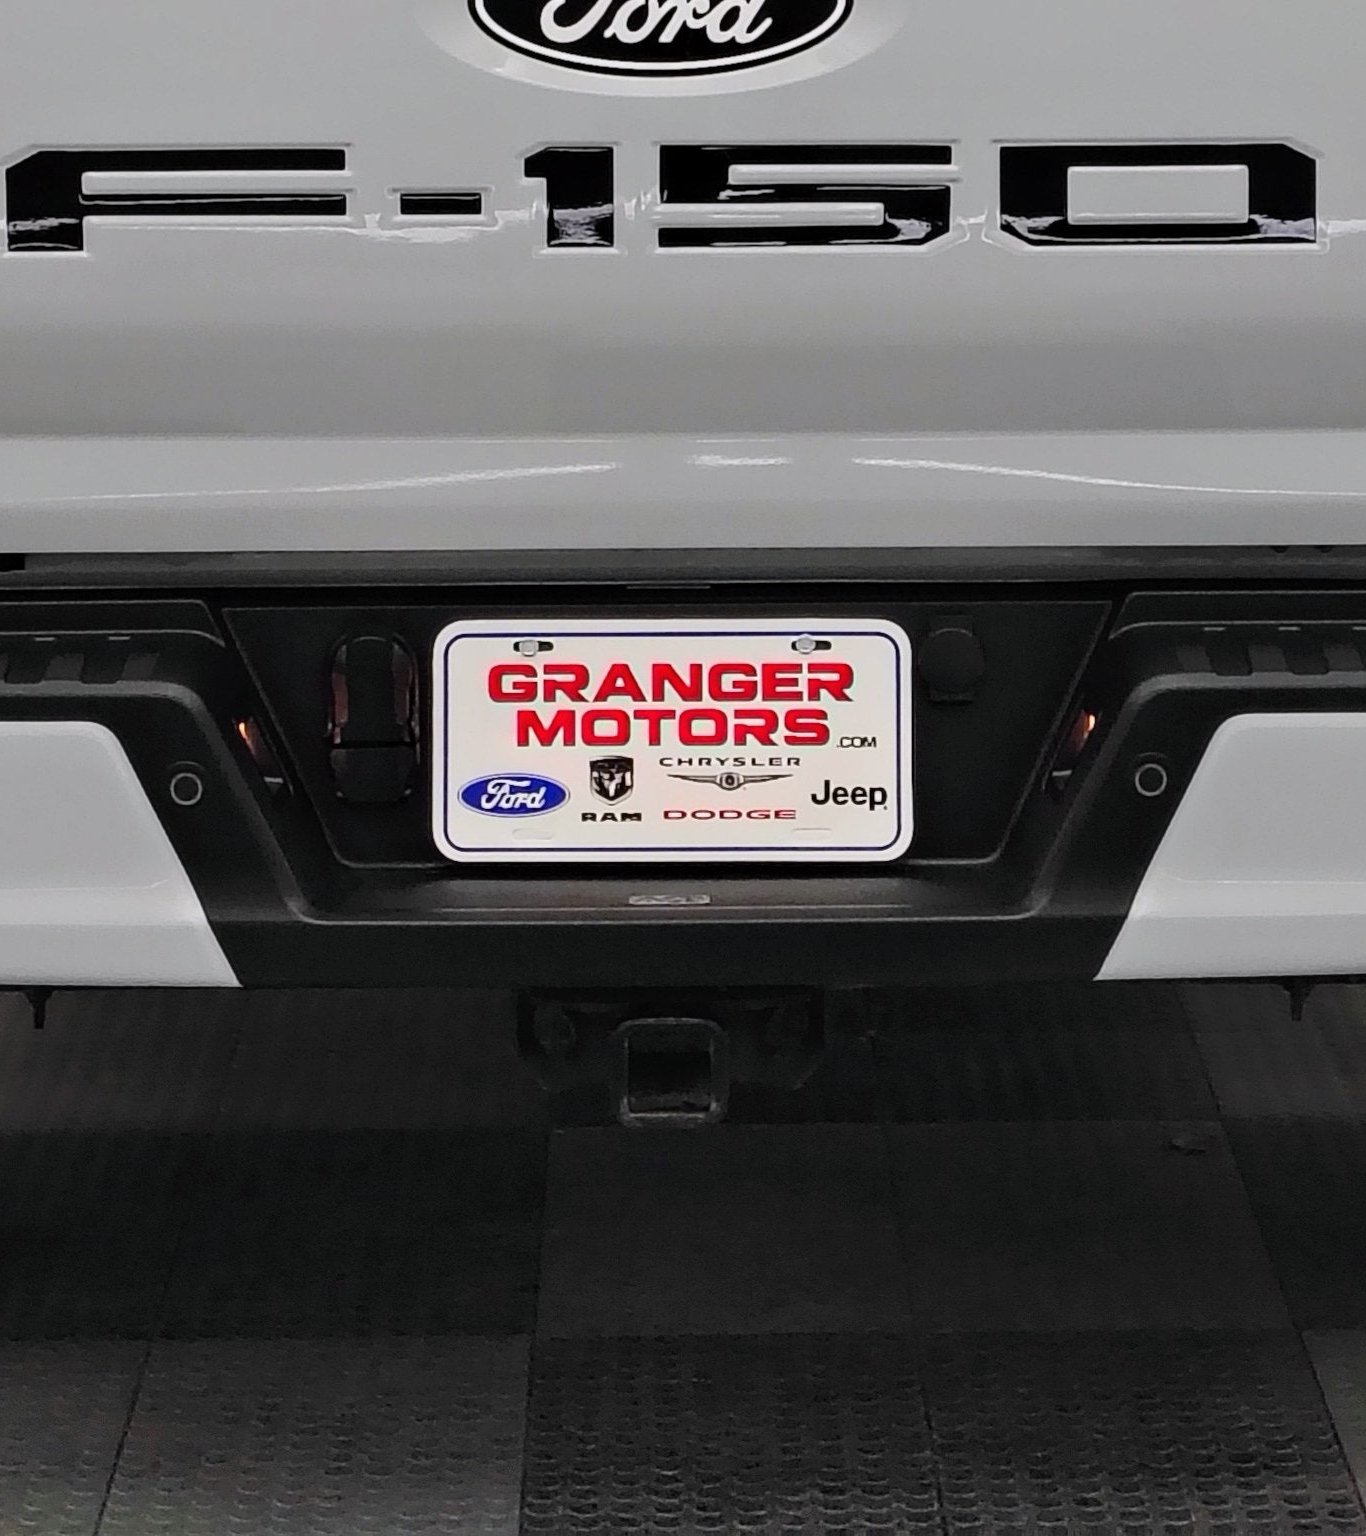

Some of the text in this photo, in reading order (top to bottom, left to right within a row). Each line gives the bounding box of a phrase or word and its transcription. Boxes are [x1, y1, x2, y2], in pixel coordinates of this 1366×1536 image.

[5, 143, 1319, 253] F-150
[487, 663, 854, 702] GRANGER
[516, 709, 878, 749] MOTORS .COM
[658, 756, 802, 767] CHRYSLER
[479, 778, 546, 810] Ford
[810, 780, 888, 811] Jeep
[581, 811, 643, 823] RAM
[662, 809, 797, 821] DODGE
